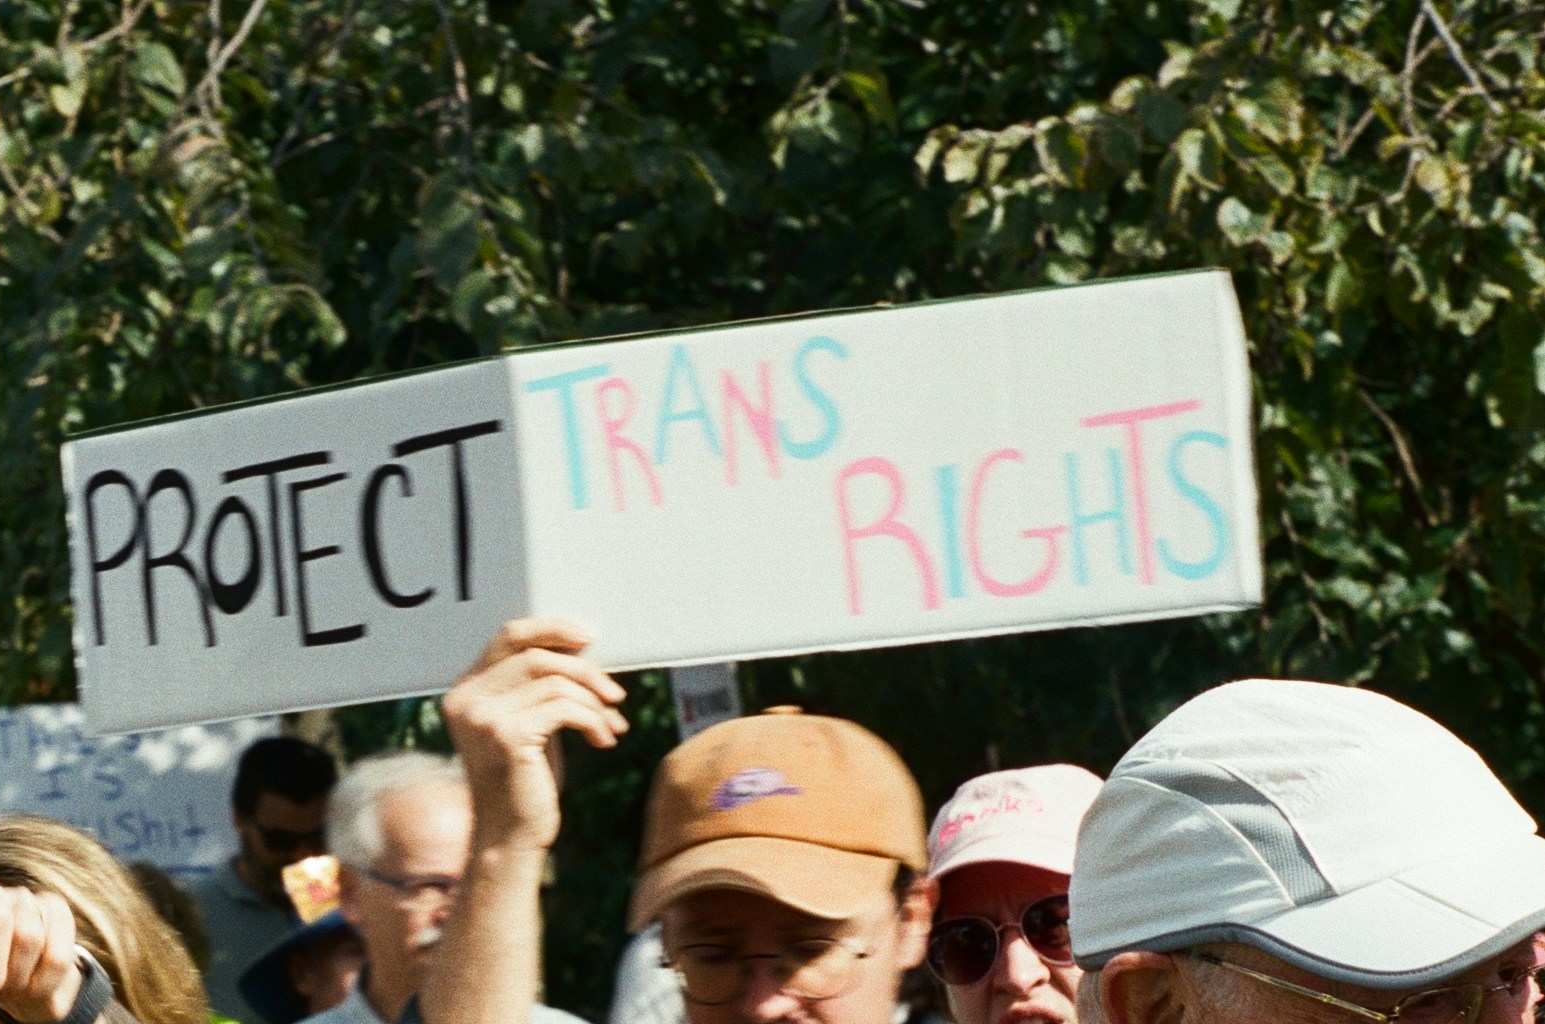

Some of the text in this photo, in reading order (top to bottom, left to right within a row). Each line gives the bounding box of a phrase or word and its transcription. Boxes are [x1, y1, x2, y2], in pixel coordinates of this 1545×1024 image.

[524, 335, 852, 513] TRANS
[833, 400, 1231, 616] RIGHTS
[83, 419, 503, 647] PROTECT
